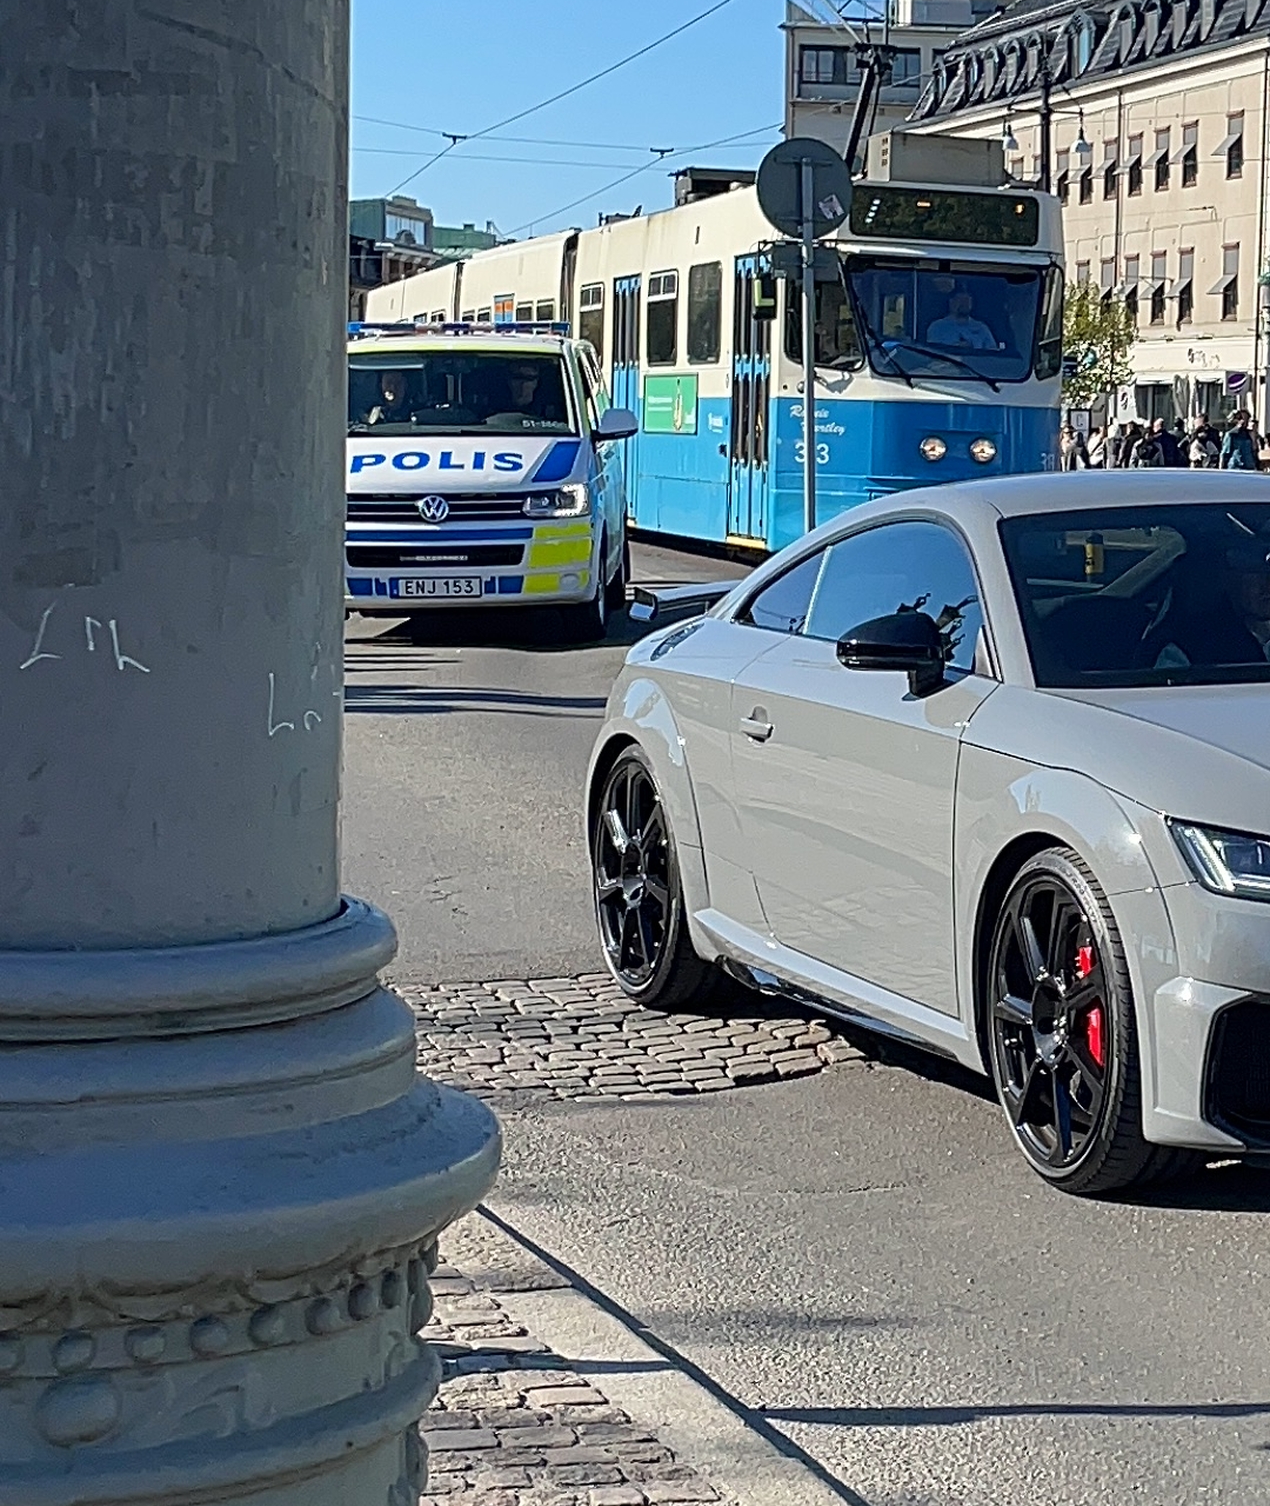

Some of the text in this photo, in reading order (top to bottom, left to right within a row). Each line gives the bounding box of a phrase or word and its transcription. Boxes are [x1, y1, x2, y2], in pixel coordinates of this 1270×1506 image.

[350, 451, 524, 474] POLIS
[405, 579, 474, 595] ENJ 153
